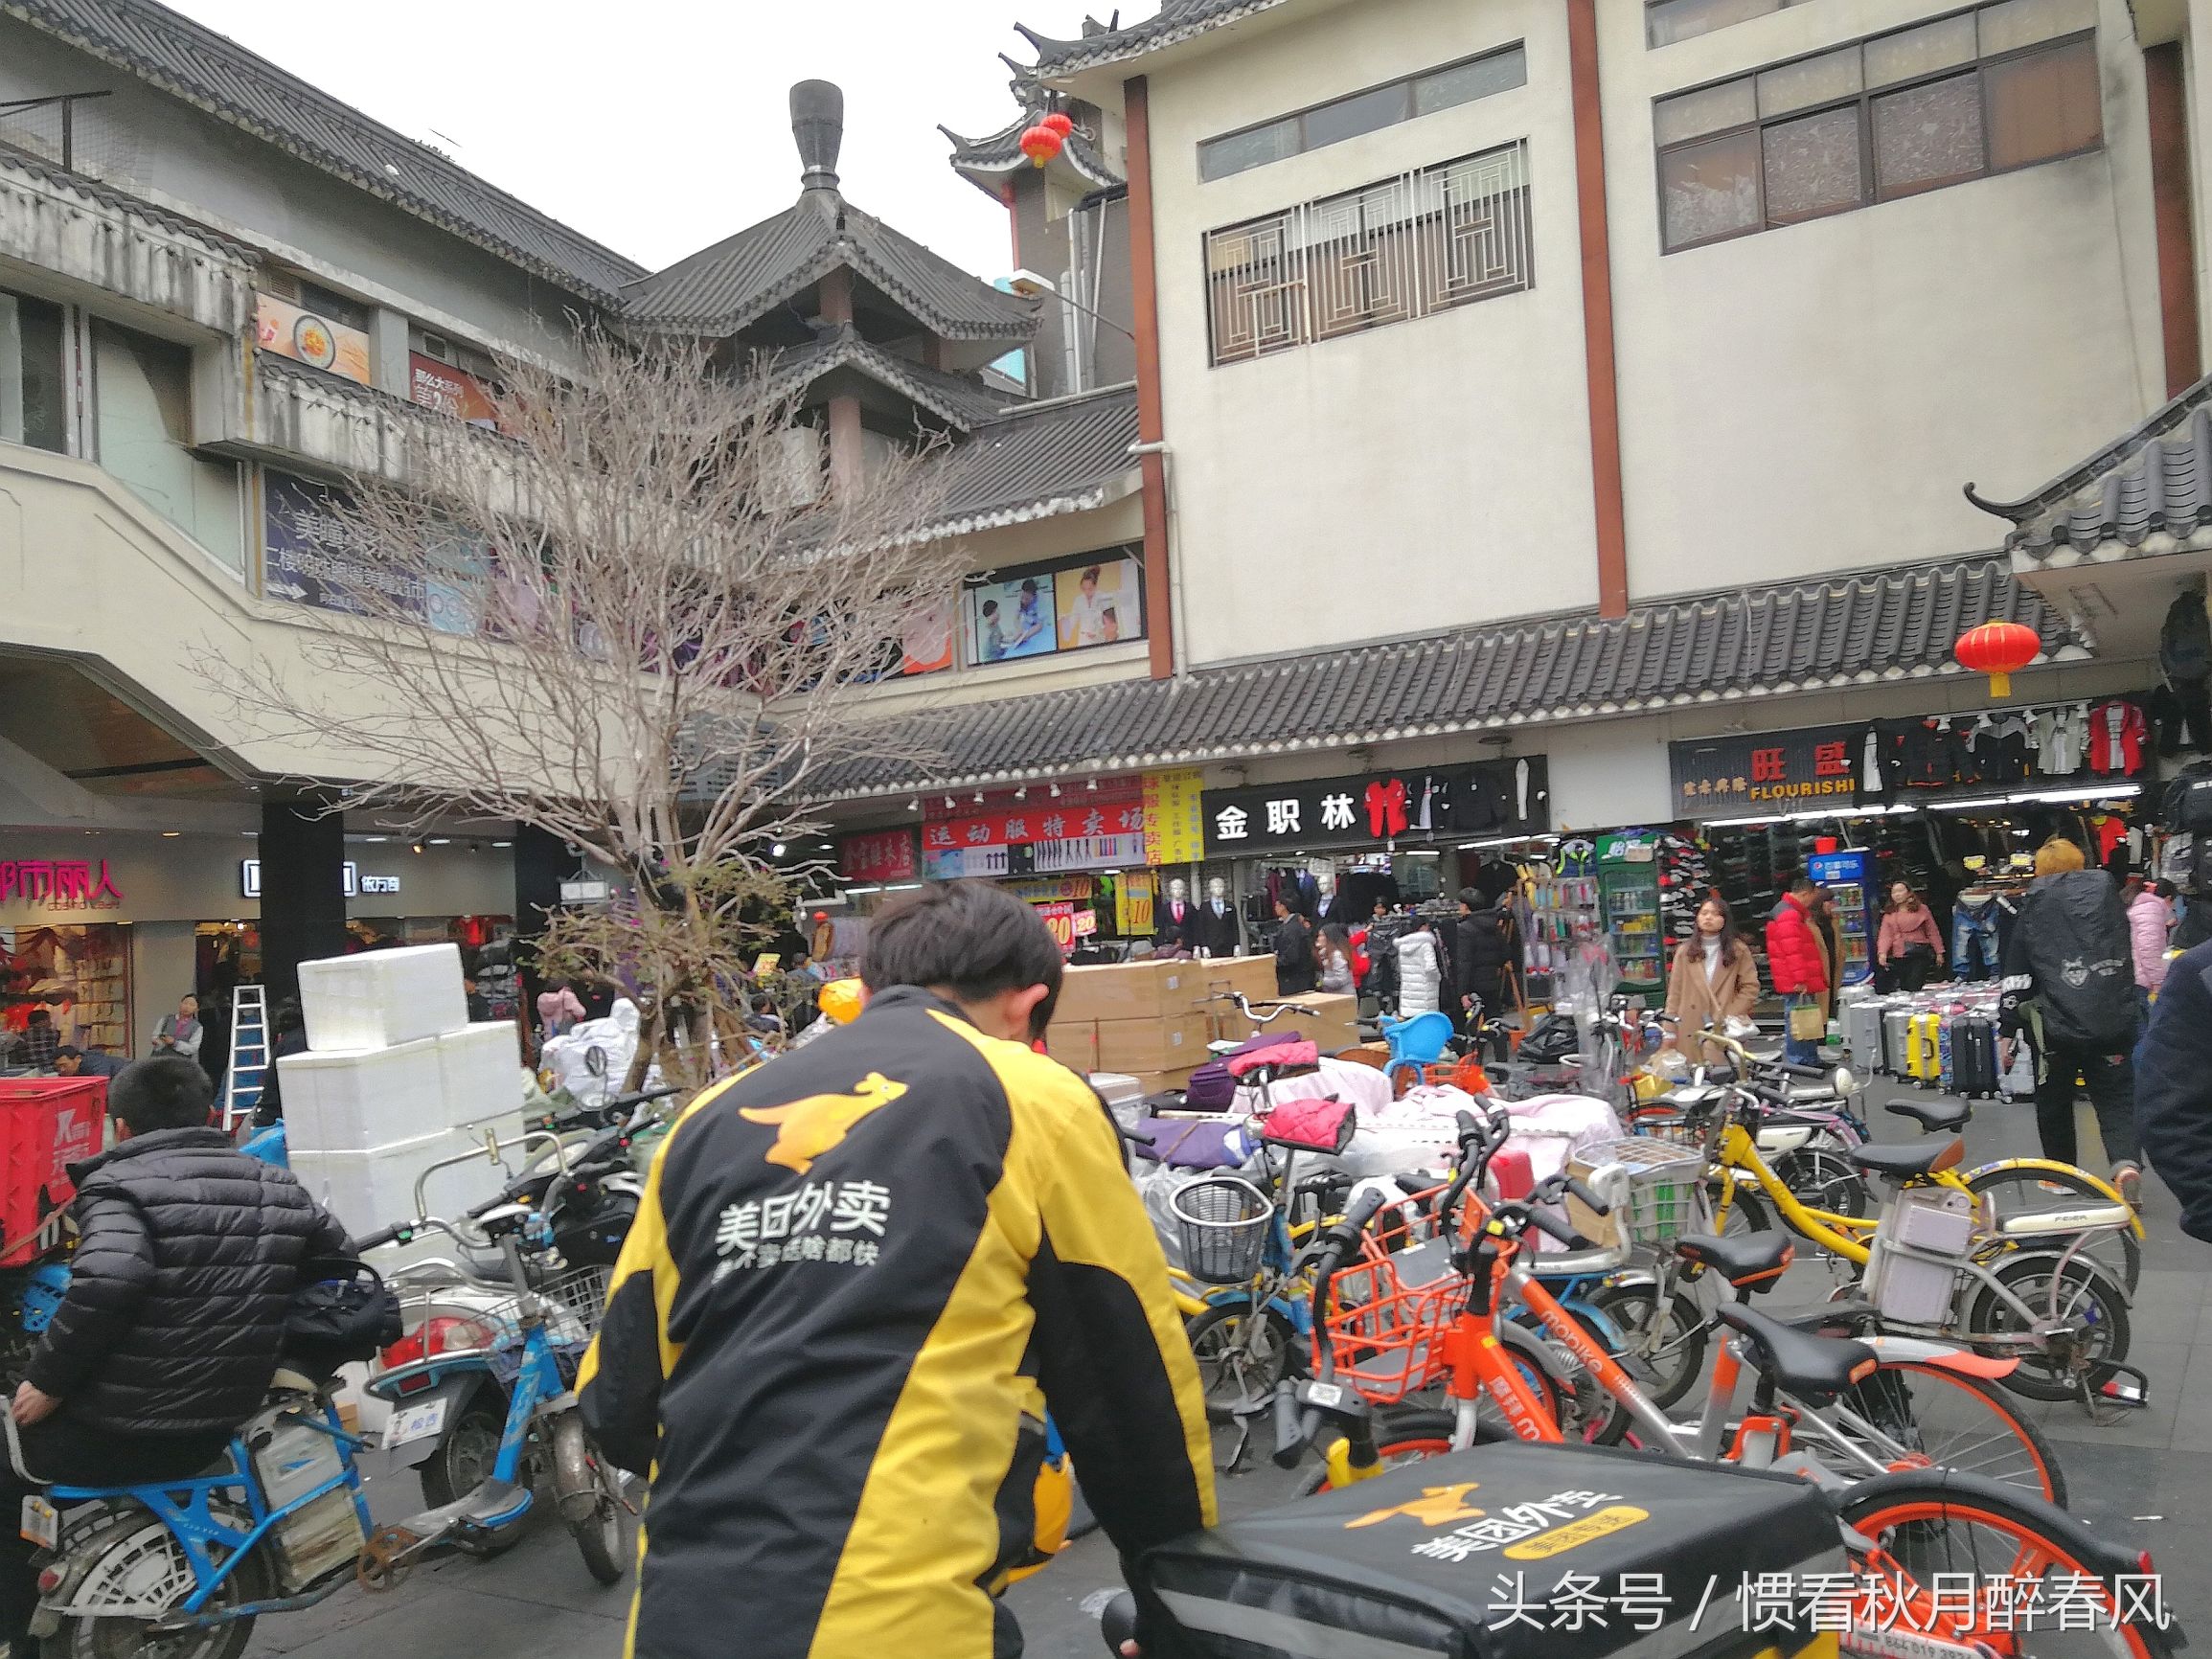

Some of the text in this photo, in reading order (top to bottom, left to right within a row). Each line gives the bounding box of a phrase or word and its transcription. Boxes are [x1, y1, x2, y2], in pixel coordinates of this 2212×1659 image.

[1215, 792, 1357, 841] 金职林
[1076, 916, 1095, 931] 20
[715, 1180, 891, 1256] 美团外卖
[1410, 1489, 1625, 1562] 美团外卖
